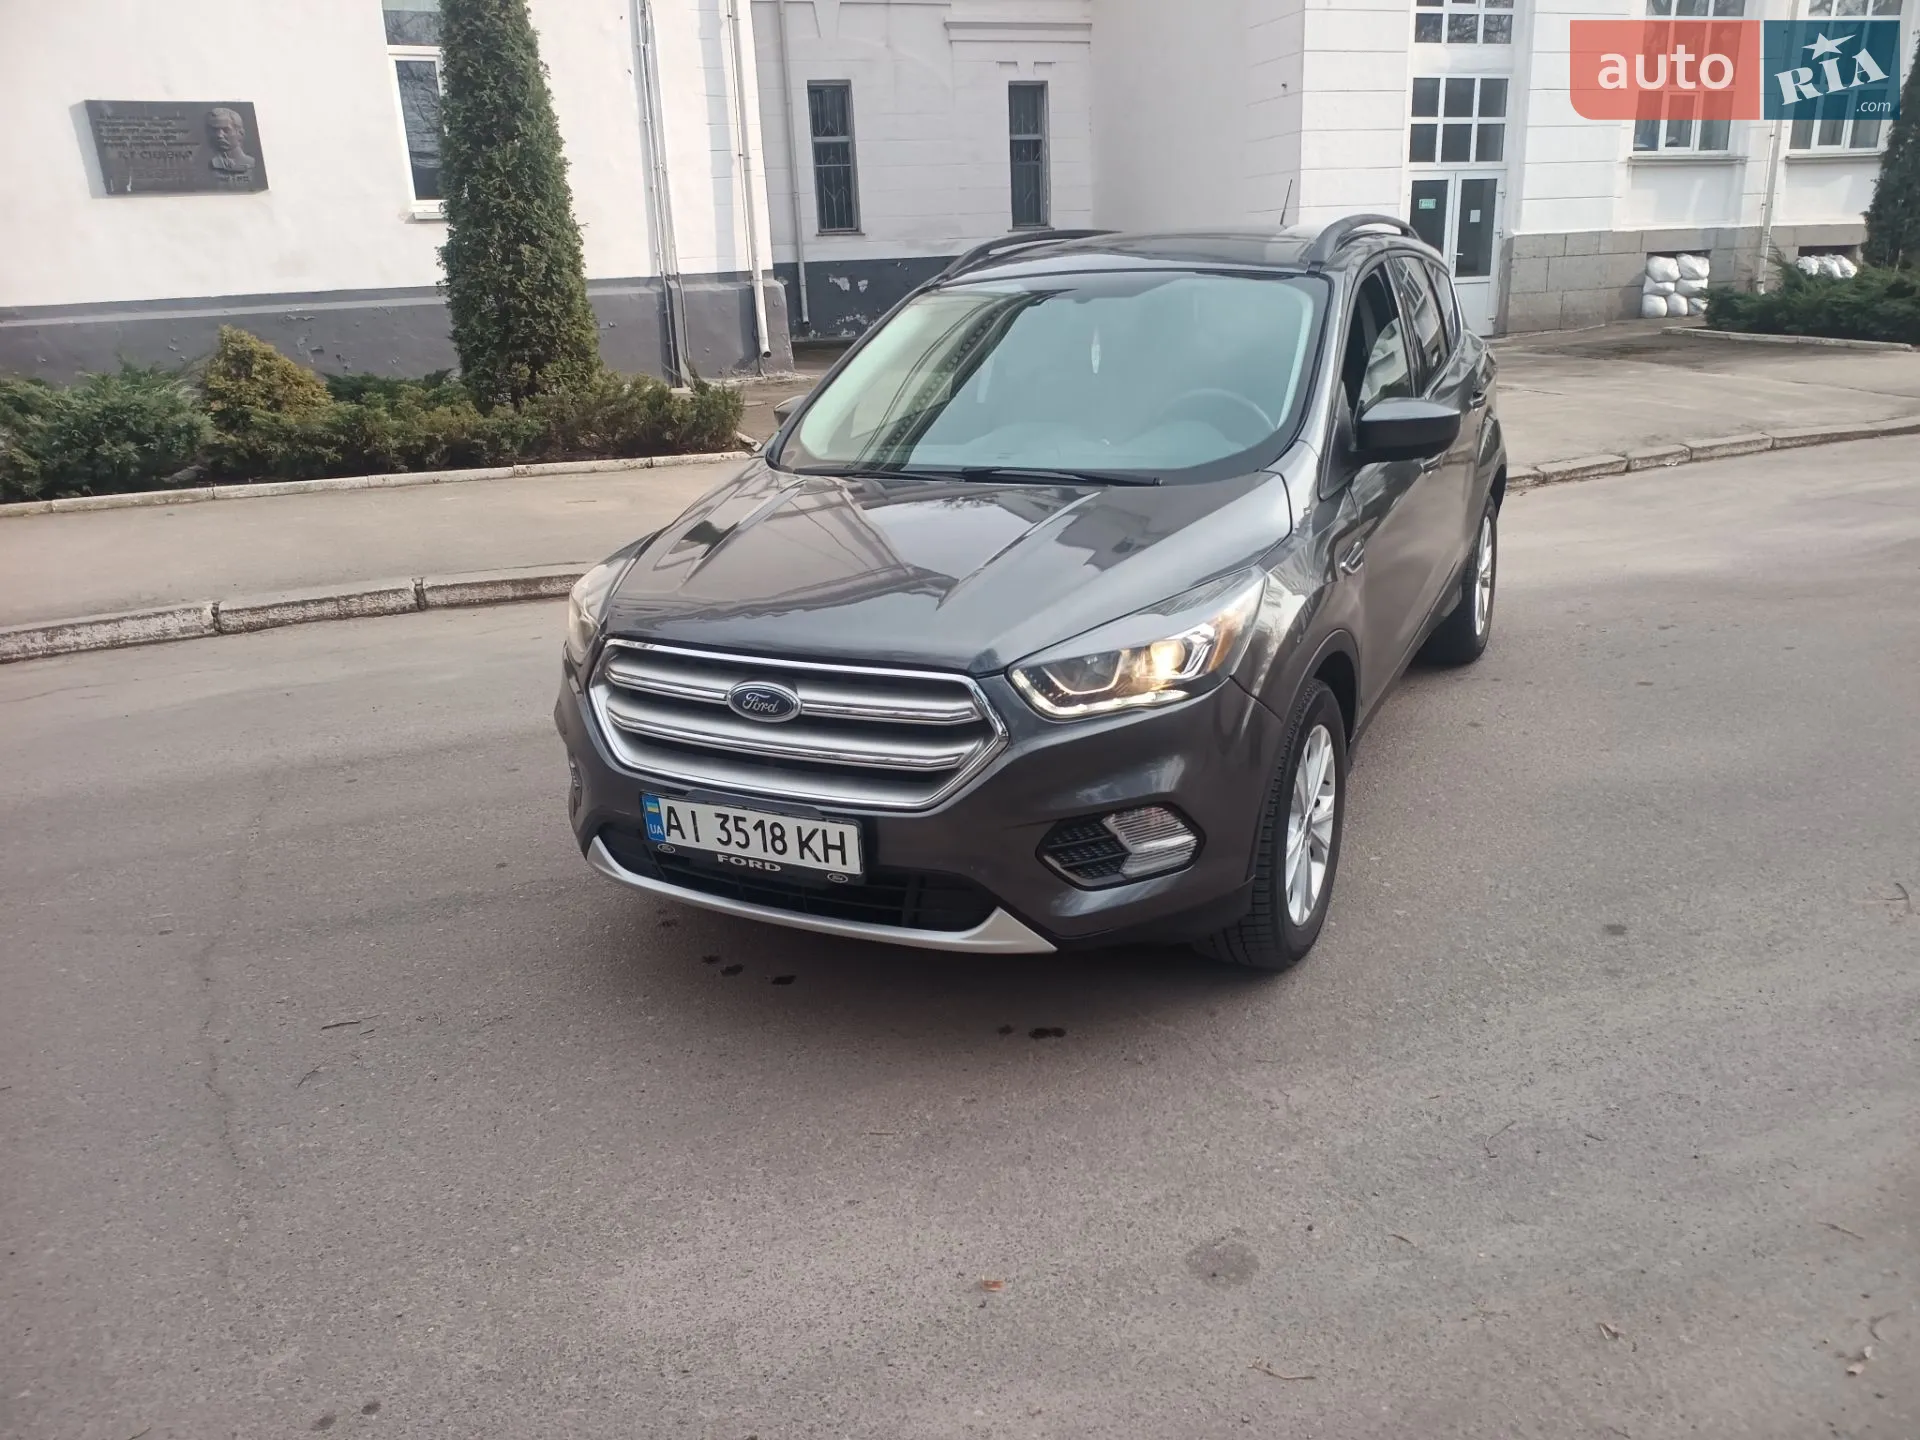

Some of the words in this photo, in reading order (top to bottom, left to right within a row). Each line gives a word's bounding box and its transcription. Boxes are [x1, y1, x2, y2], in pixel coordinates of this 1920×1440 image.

[743, 692, 780, 713] Ford
[650, 824, 664, 836] UA
[666, 805, 700, 843] AI
[714, 812, 788, 856] 3518
[796, 825, 847, 866] KH
[716, 853, 782, 873] FORD
